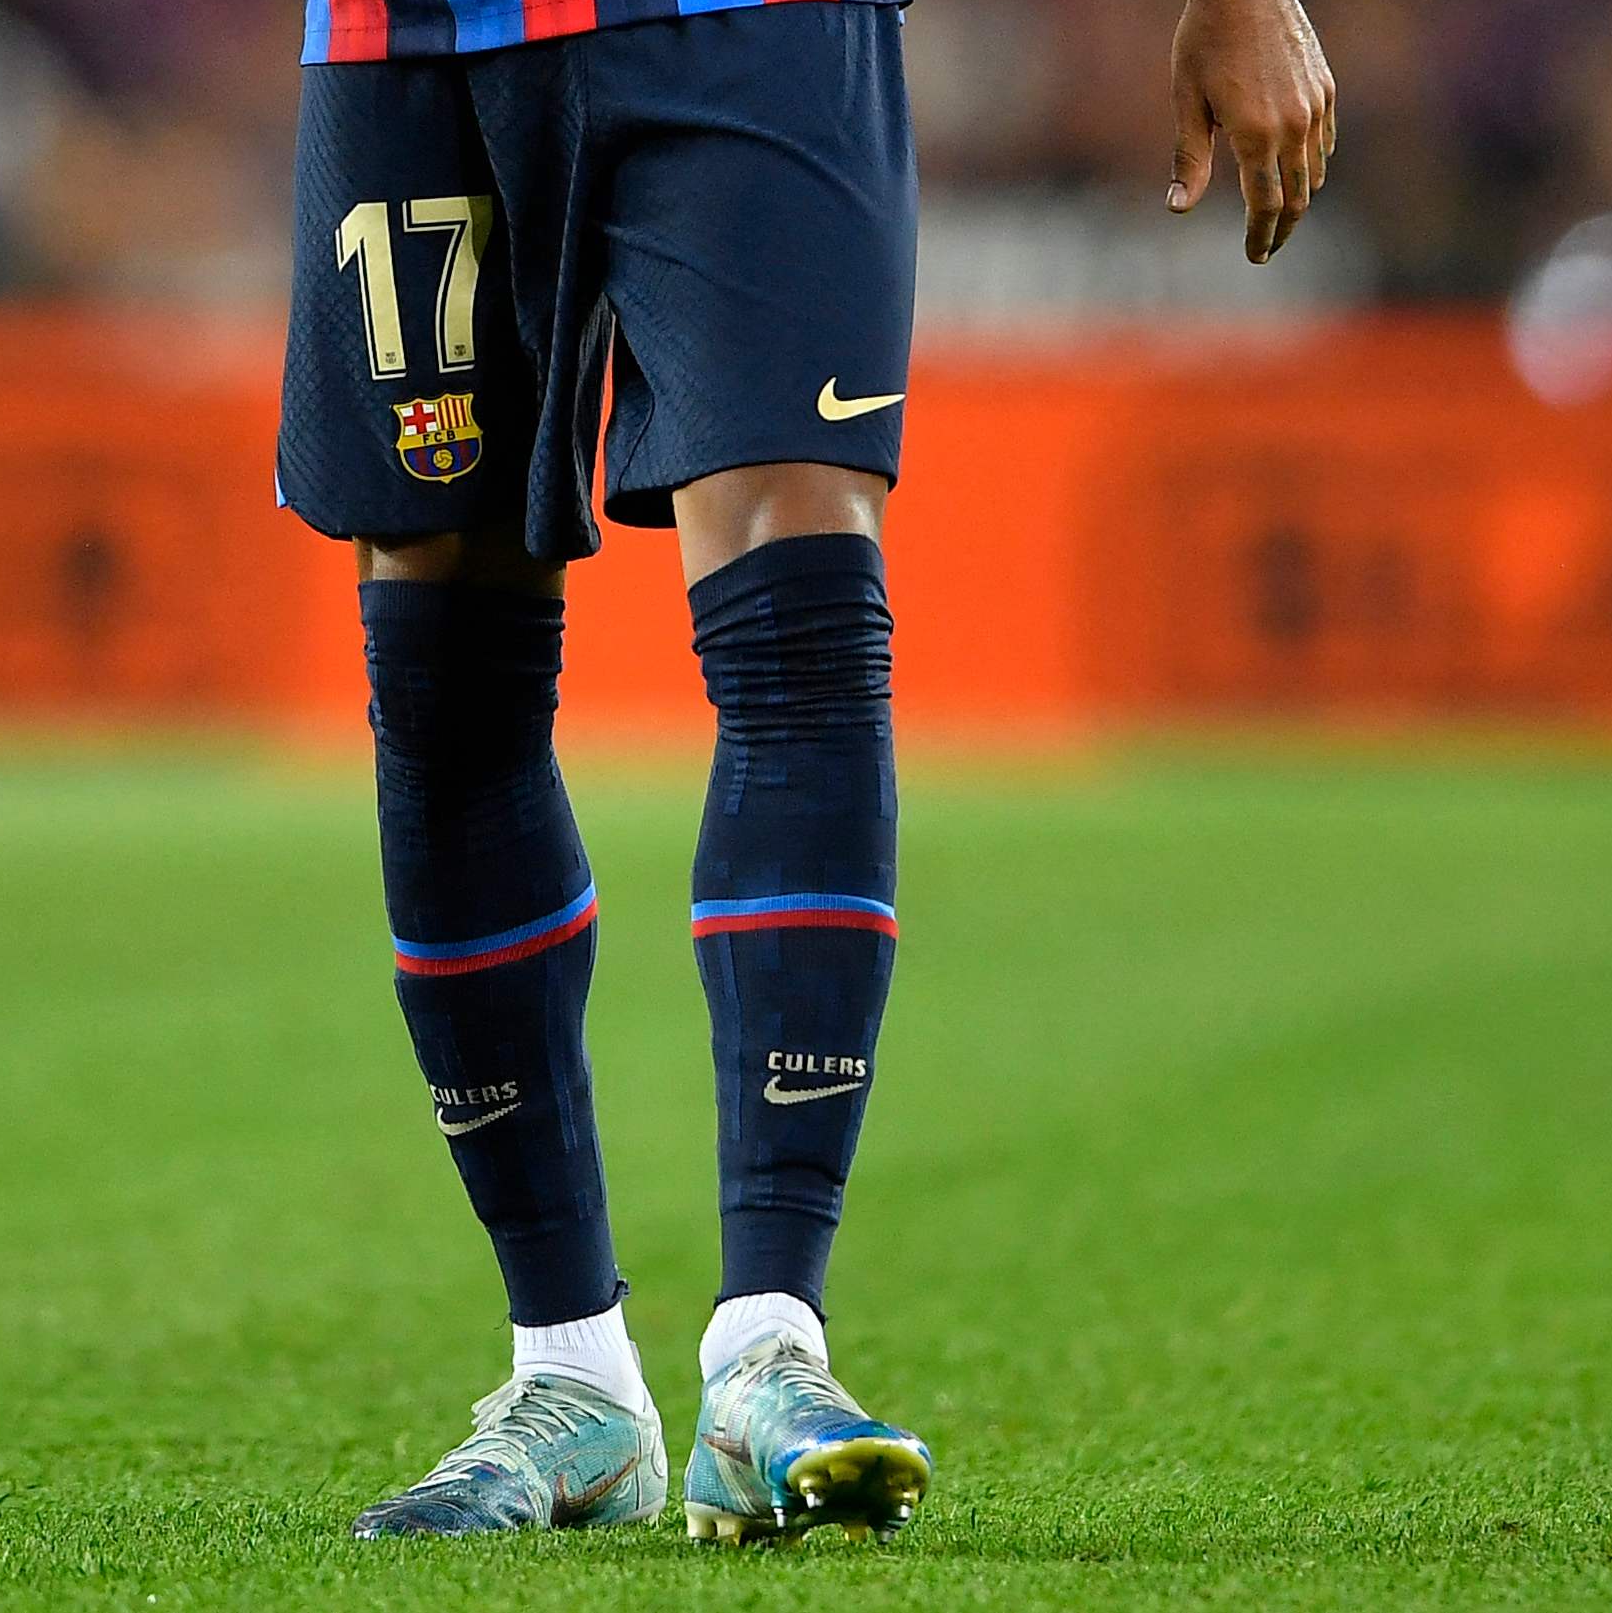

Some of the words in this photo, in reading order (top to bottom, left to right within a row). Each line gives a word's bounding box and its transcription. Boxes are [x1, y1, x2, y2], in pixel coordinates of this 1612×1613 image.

[335, 196, 492, 380] 17
[422, 430, 456, 444] FCB
[768, 1051, 866, 1077] CULERS
[429, 1081, 518, 1105] CULERS
